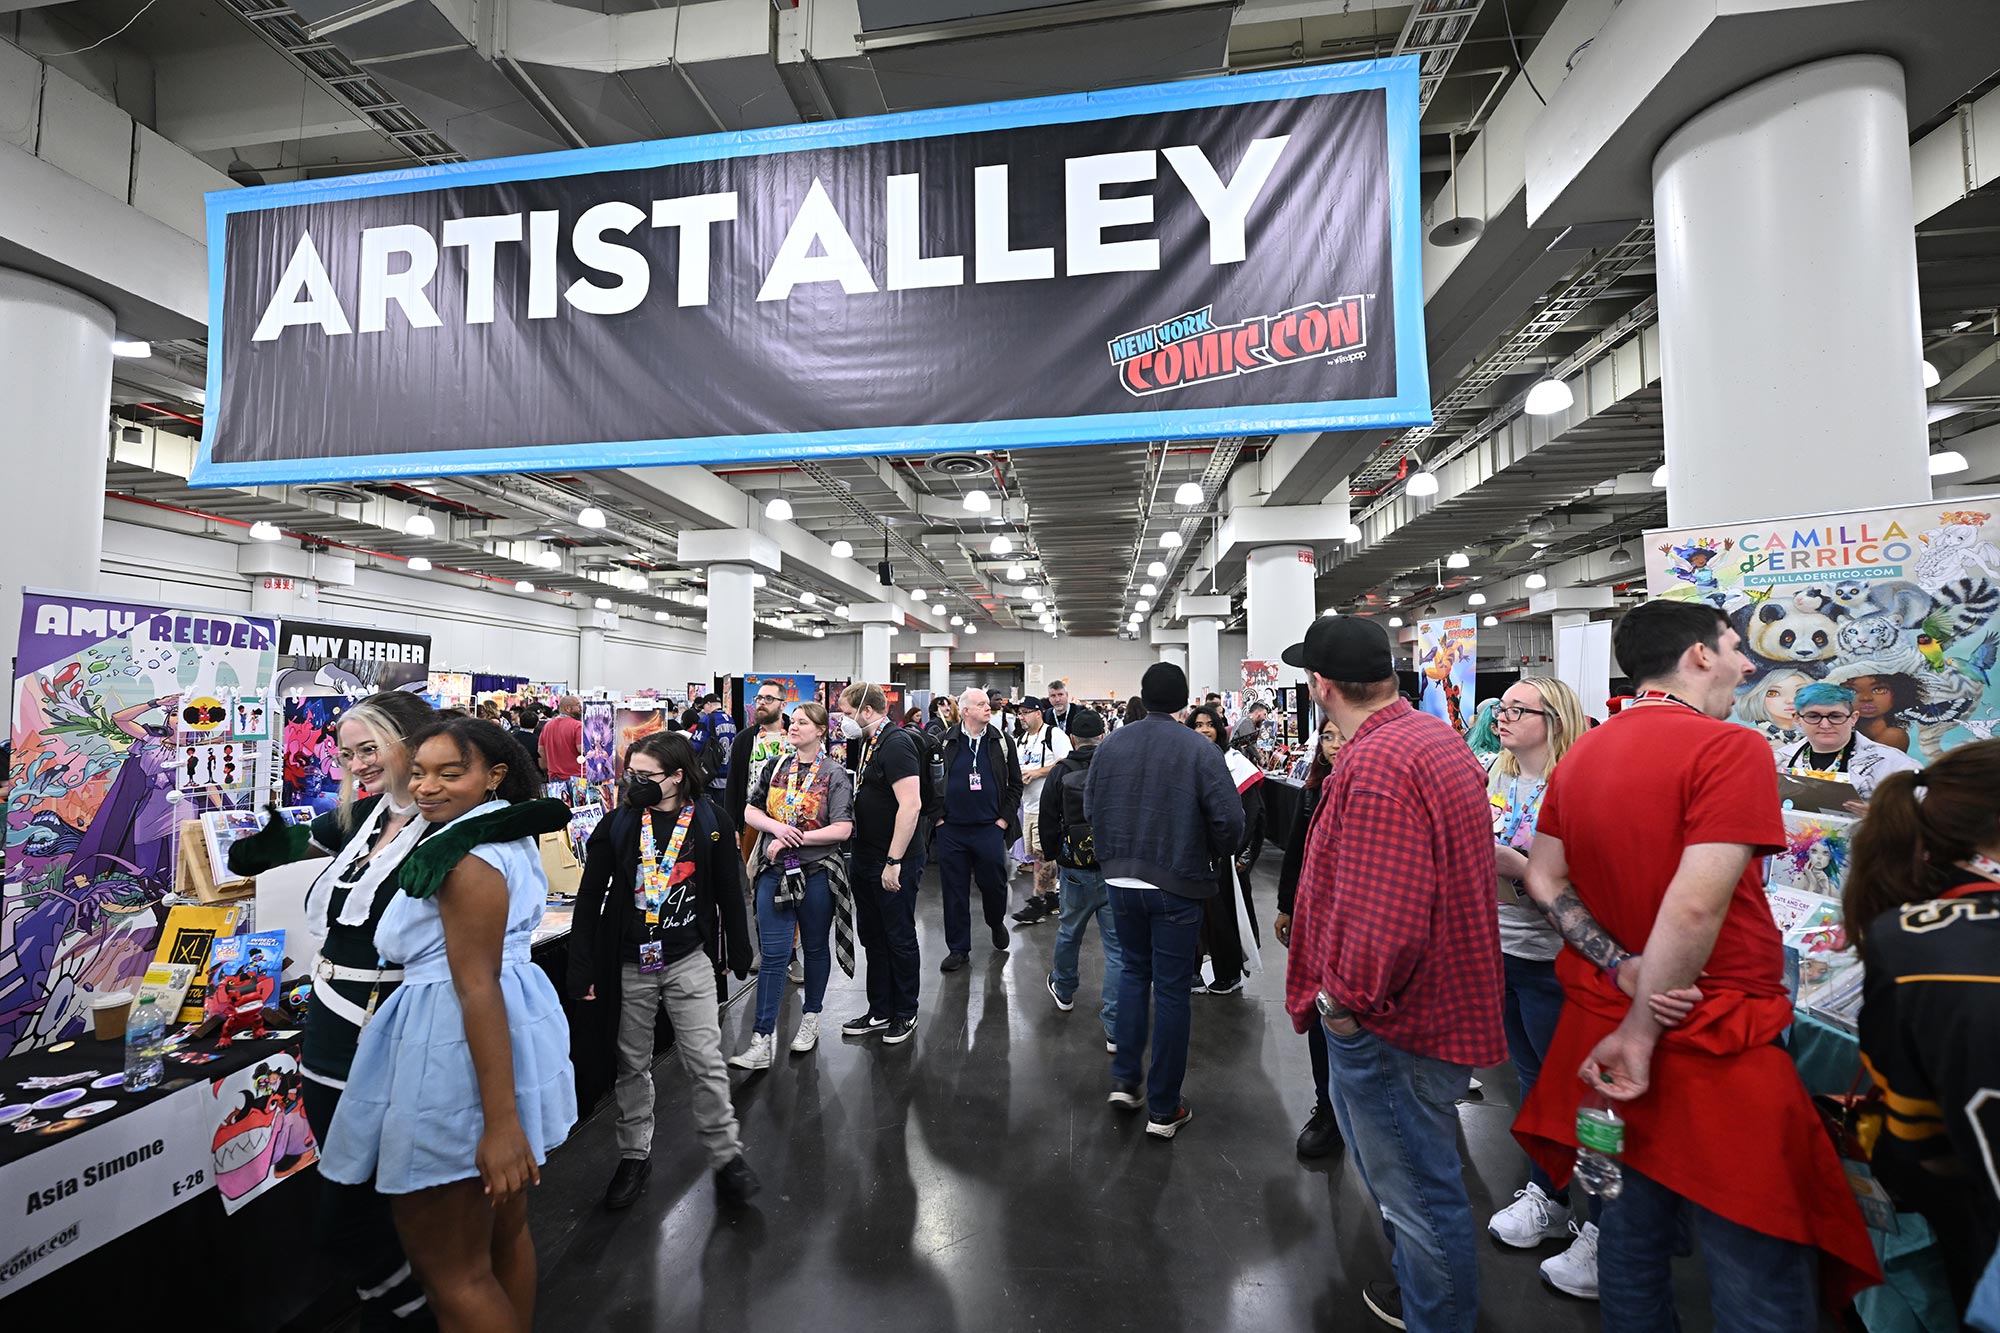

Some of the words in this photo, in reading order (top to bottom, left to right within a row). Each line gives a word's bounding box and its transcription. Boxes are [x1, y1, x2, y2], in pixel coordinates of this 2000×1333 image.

[251, 191, 738, 342] ARTIST
[756, 134, 1293, 303] ALLEY
[1112, 329, 1154, 361] NEW
[1157, 310, 1212, 345] YORK
[1126, 324, 1260, 390] COMIC
[1270, 302, 1360, 358] CON
[1739, 520, 1909, 552] CAMILLA
[1750, 567, 1895, 585] CAMILLADERRICO.COM
[35, 603, 136, 638] AMY
[149, 614, 271, 651] REEDER
[288, 634, 344, 659] AMY
[348, 639, 425, 664] REEDER
[177, 937, 201, 964] XL
[26, 1178, 79, 1215] Asia
[82, 1138, 165, 1188] Simone
[172, 1169, 205, 1197] E-28
[0, 1244, 46, 1281] COMIC
[49, 1224, 78, 1249] CON
